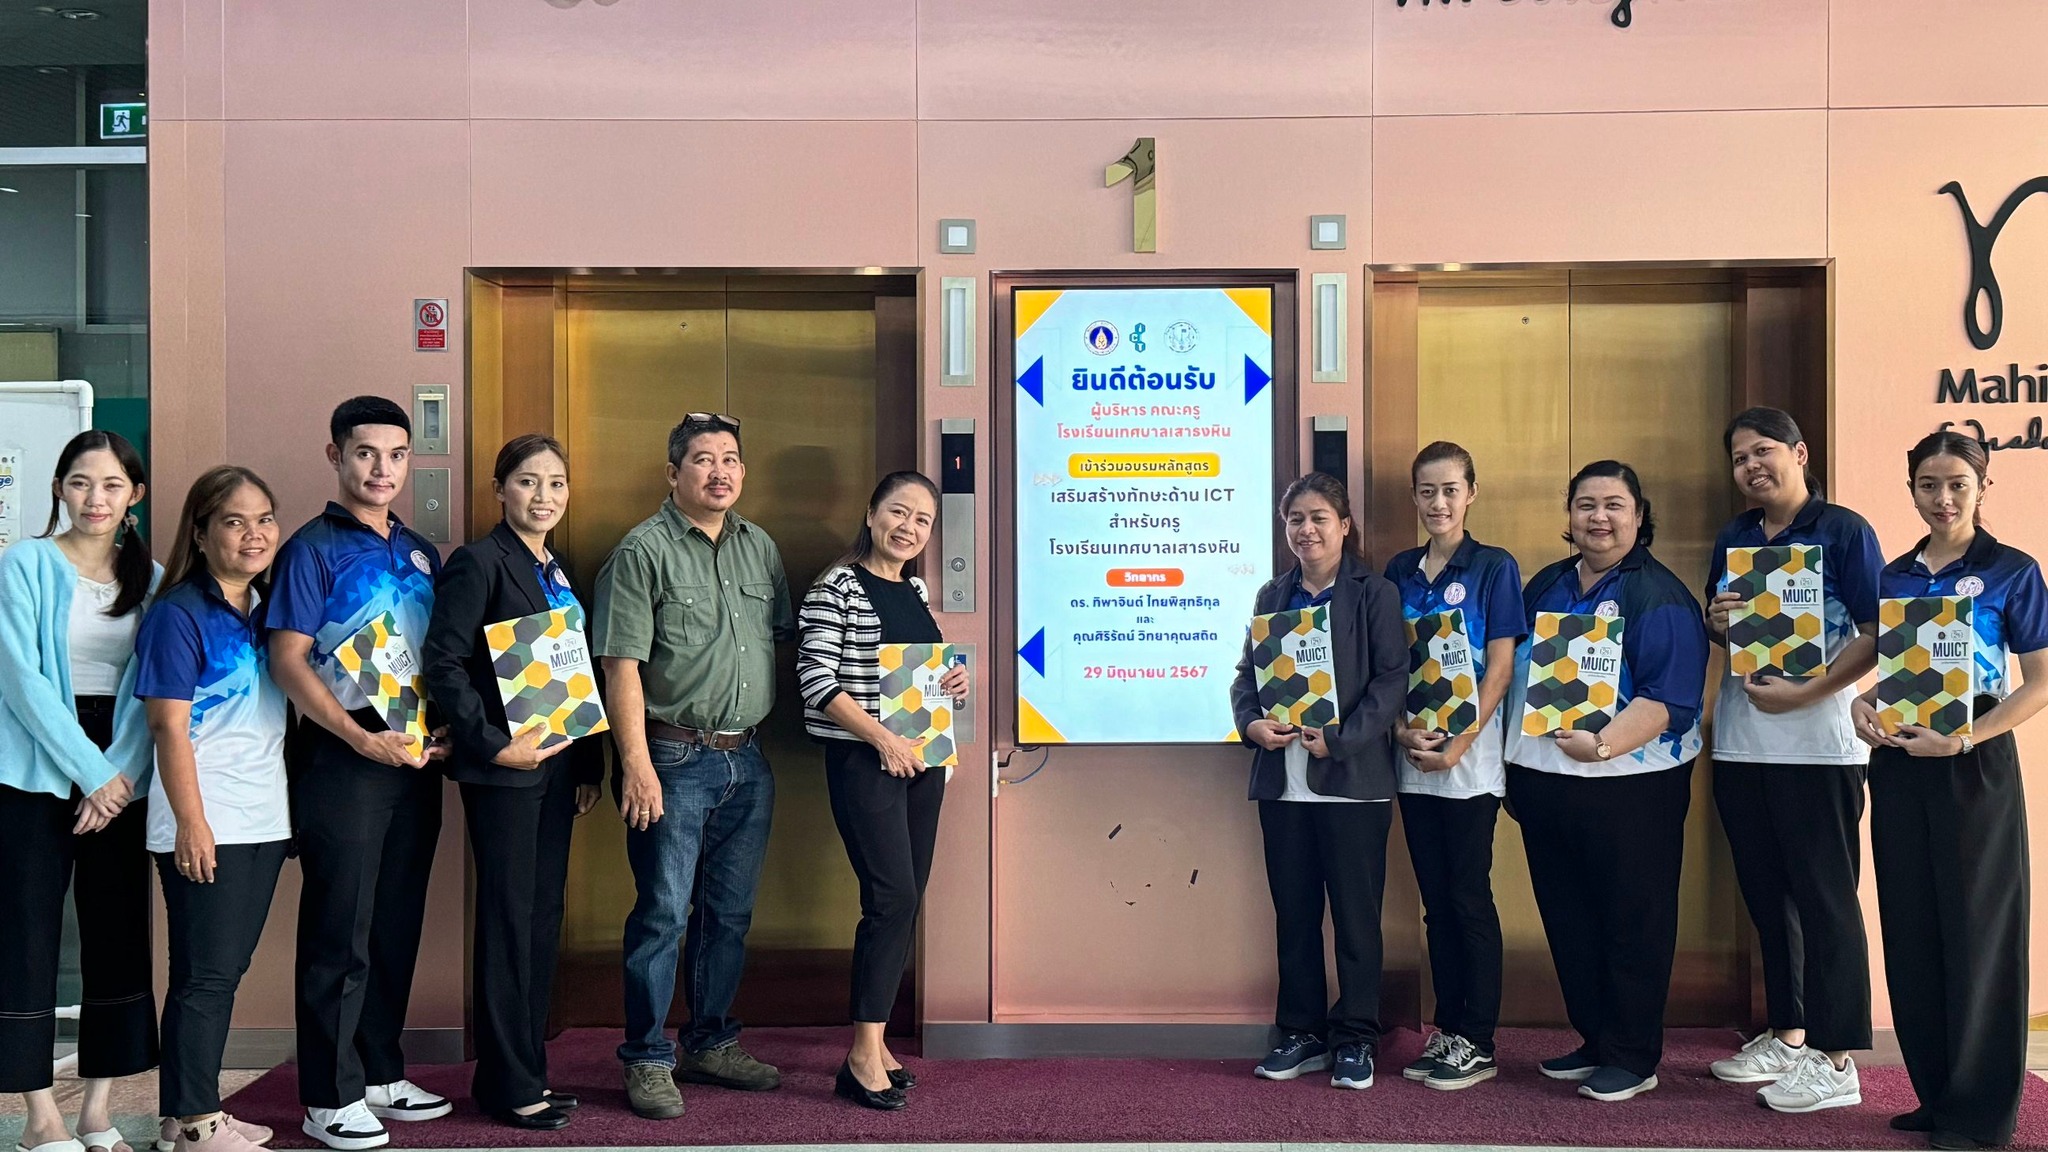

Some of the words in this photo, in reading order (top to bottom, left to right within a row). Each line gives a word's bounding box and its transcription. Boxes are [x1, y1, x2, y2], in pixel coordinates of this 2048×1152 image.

[1105, 137, 1156, 253] 1
[1072, 364, 1216, 391] ยินดีต้อนรับ
[1091, 401, 1147, 421] ผู้บริหาร
[1151, 405, 1201, 420] คณะครู
[1057, 423, 1231, 439] โรงเรียนเทศบาลเสาธงหิน
[955, 456, 961, 470] 1
[1080, 459, 1210, 475] เข้าร่วมอบรมหลักสูตร
[1051, 486, 1200, 504] เสริมสร้างทักษะด้าน
[1204, 488, 1235, 502] ICT
[1109, 512, 1181, 533] สำหรับครู
[1049, 538, 1241, 555] โรงเรียนเทศบาลเสาธงหิน
[1070, 598, 1089, 608] ดร.
[1783, 588, 1818, 603] MUICT
[1136, 615, 1155, 624] และ
[1073, 629, 1135, 645] คุณศิริรัตน์
[549, 647, 585, 669] MUICT
[1296, 646, 1328, 663] MUICT
[1932, 641, 1969, 658] MUICT
[388, 649, 412, 677] MUICT
[1441, 649, 1468, 668] MUICT
[1580, 656, 1617, 673] MUICT
[1083, 665, 1103, 679] 29
[1106, 665, 1166, 683] มิถุนายน
[1170, 665, 1209, 679] 2567
[924, 683, 947, 698] MUIC
